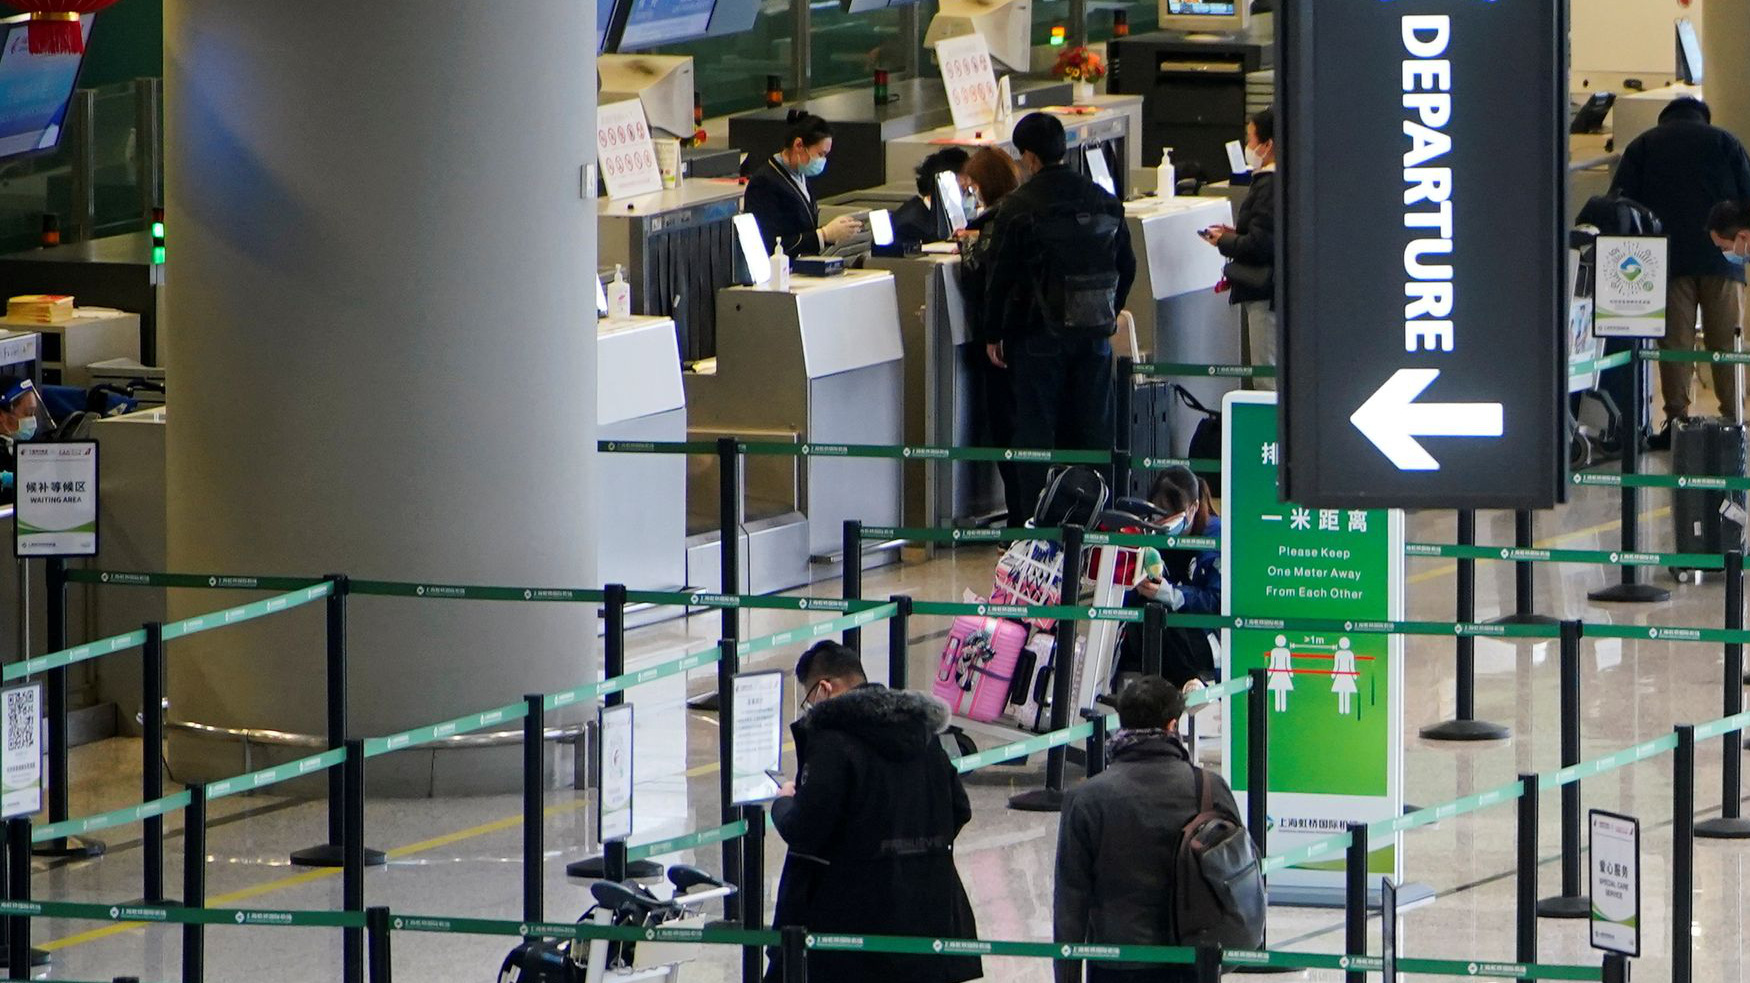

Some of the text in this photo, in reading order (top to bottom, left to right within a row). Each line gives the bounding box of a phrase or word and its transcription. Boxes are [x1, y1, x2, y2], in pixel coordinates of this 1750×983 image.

[1401, 14, 1454, 352] DEPARTURE
[30, 496, 62, 504] WAITING
[1261, 507, 1368, 532] 一米距离
[1278, 546, 1351, 560] Please Keep
[1267, 566, 1361, 581] One Meter Away
[1266, 585, 1363, 599] From Each Other
